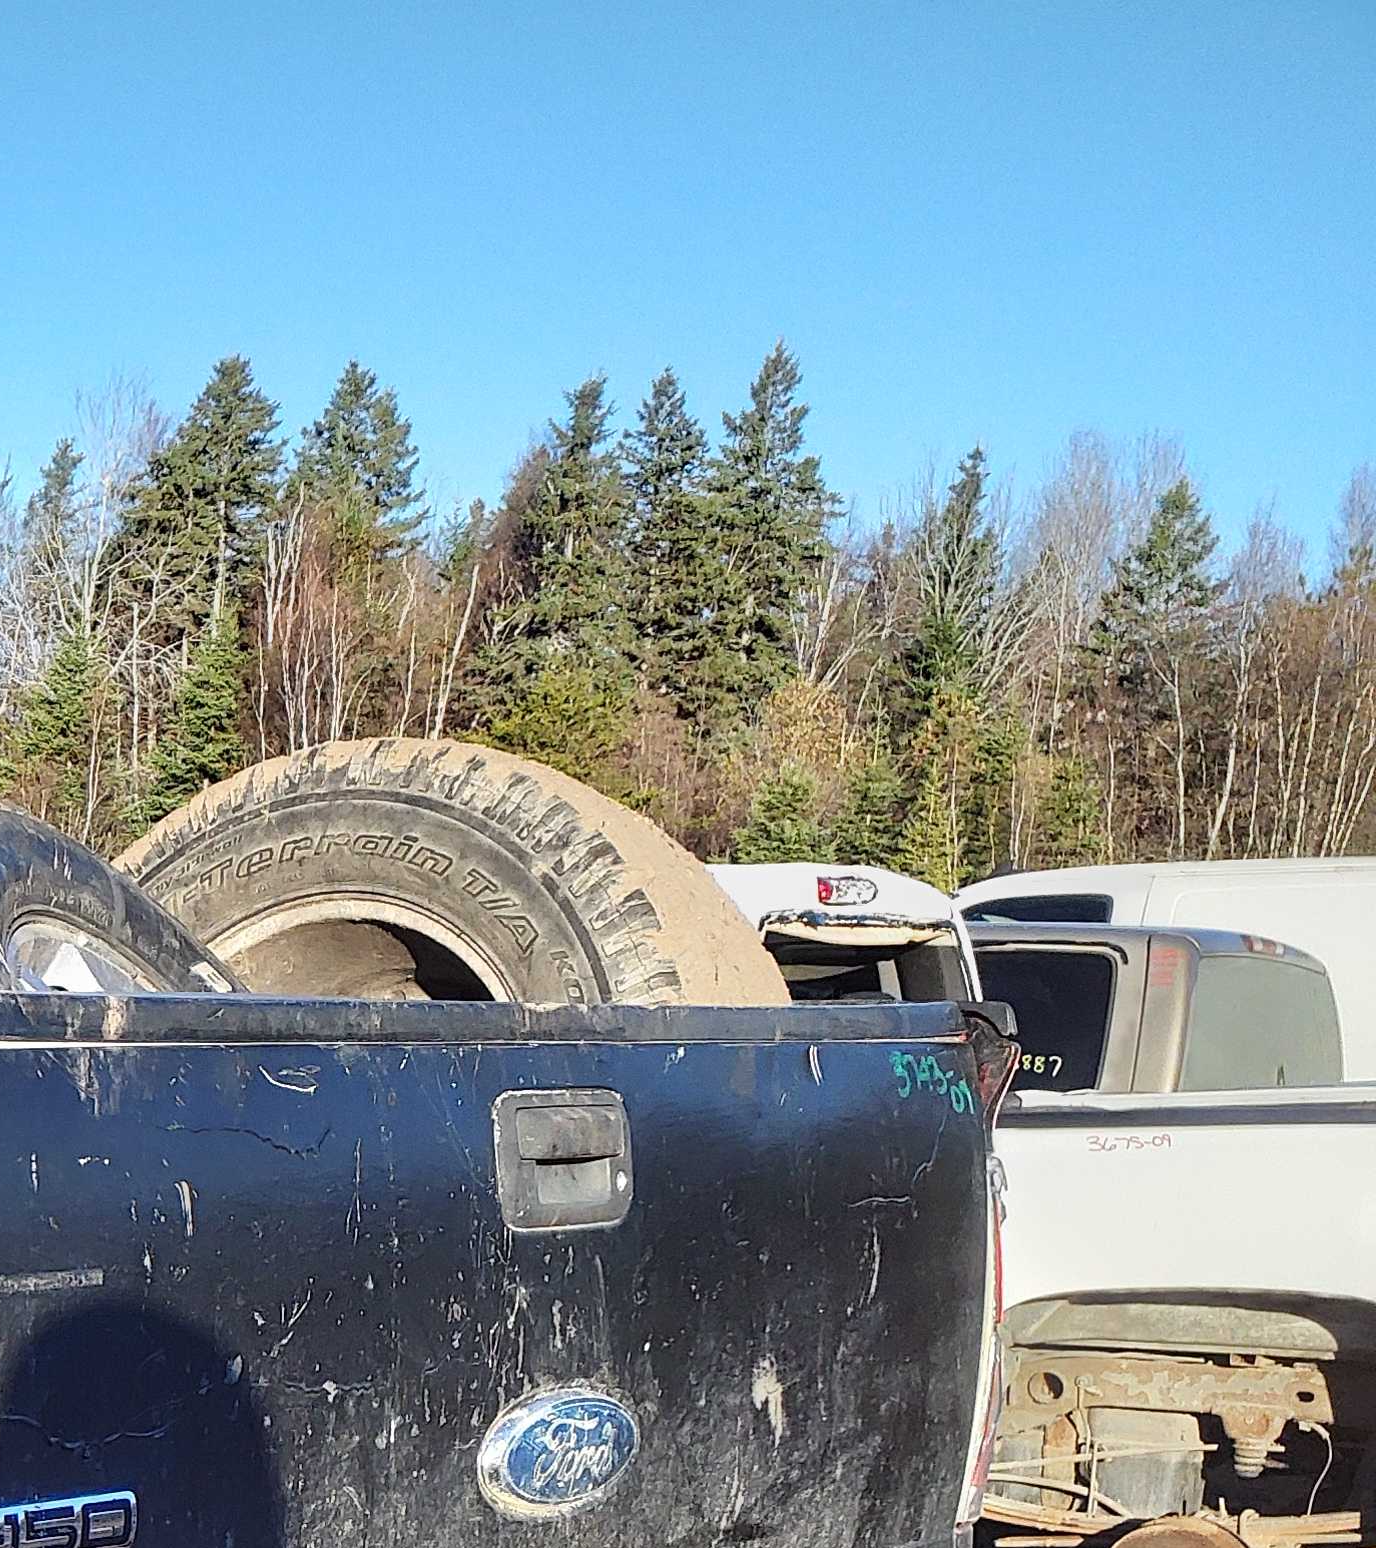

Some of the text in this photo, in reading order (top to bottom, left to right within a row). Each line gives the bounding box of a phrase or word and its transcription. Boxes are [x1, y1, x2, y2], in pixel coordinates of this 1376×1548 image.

[462, 868, 539, 956] T/A
[1020, 1054, 1063, 1077] 887
[1086, 1134, 1172, 1152] 3675-09
[533, 1415, 617, 1488] Ford
